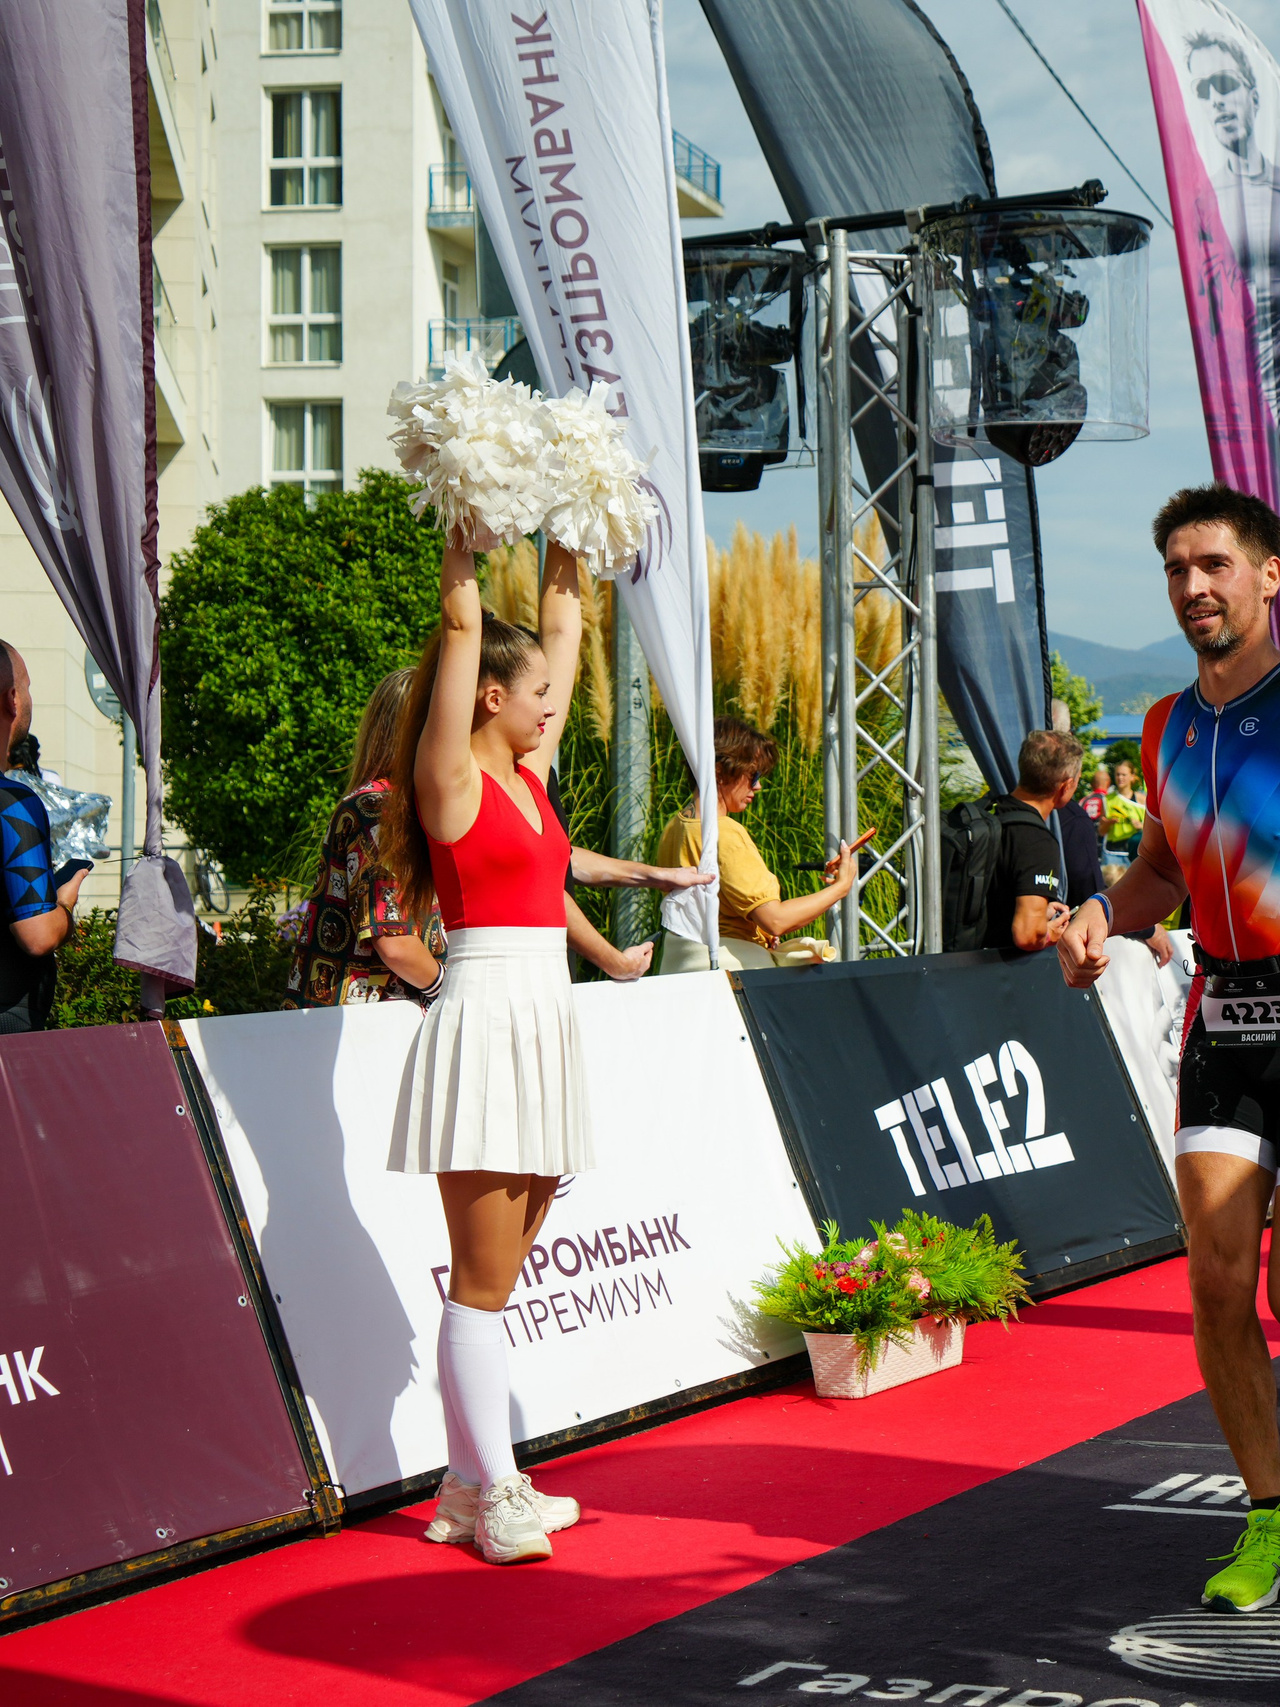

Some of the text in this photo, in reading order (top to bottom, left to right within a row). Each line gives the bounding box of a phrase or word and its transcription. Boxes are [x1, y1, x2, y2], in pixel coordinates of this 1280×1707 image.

[1241, 1031, 1277, 1042] ВАСИЛИЙ
[874, 1040, 1076, 1197] TELE2
[430, 1213, 692, 1306] ГРОМБАНК
[503, 1268, 673, 1348] ПРЕМИУМ
